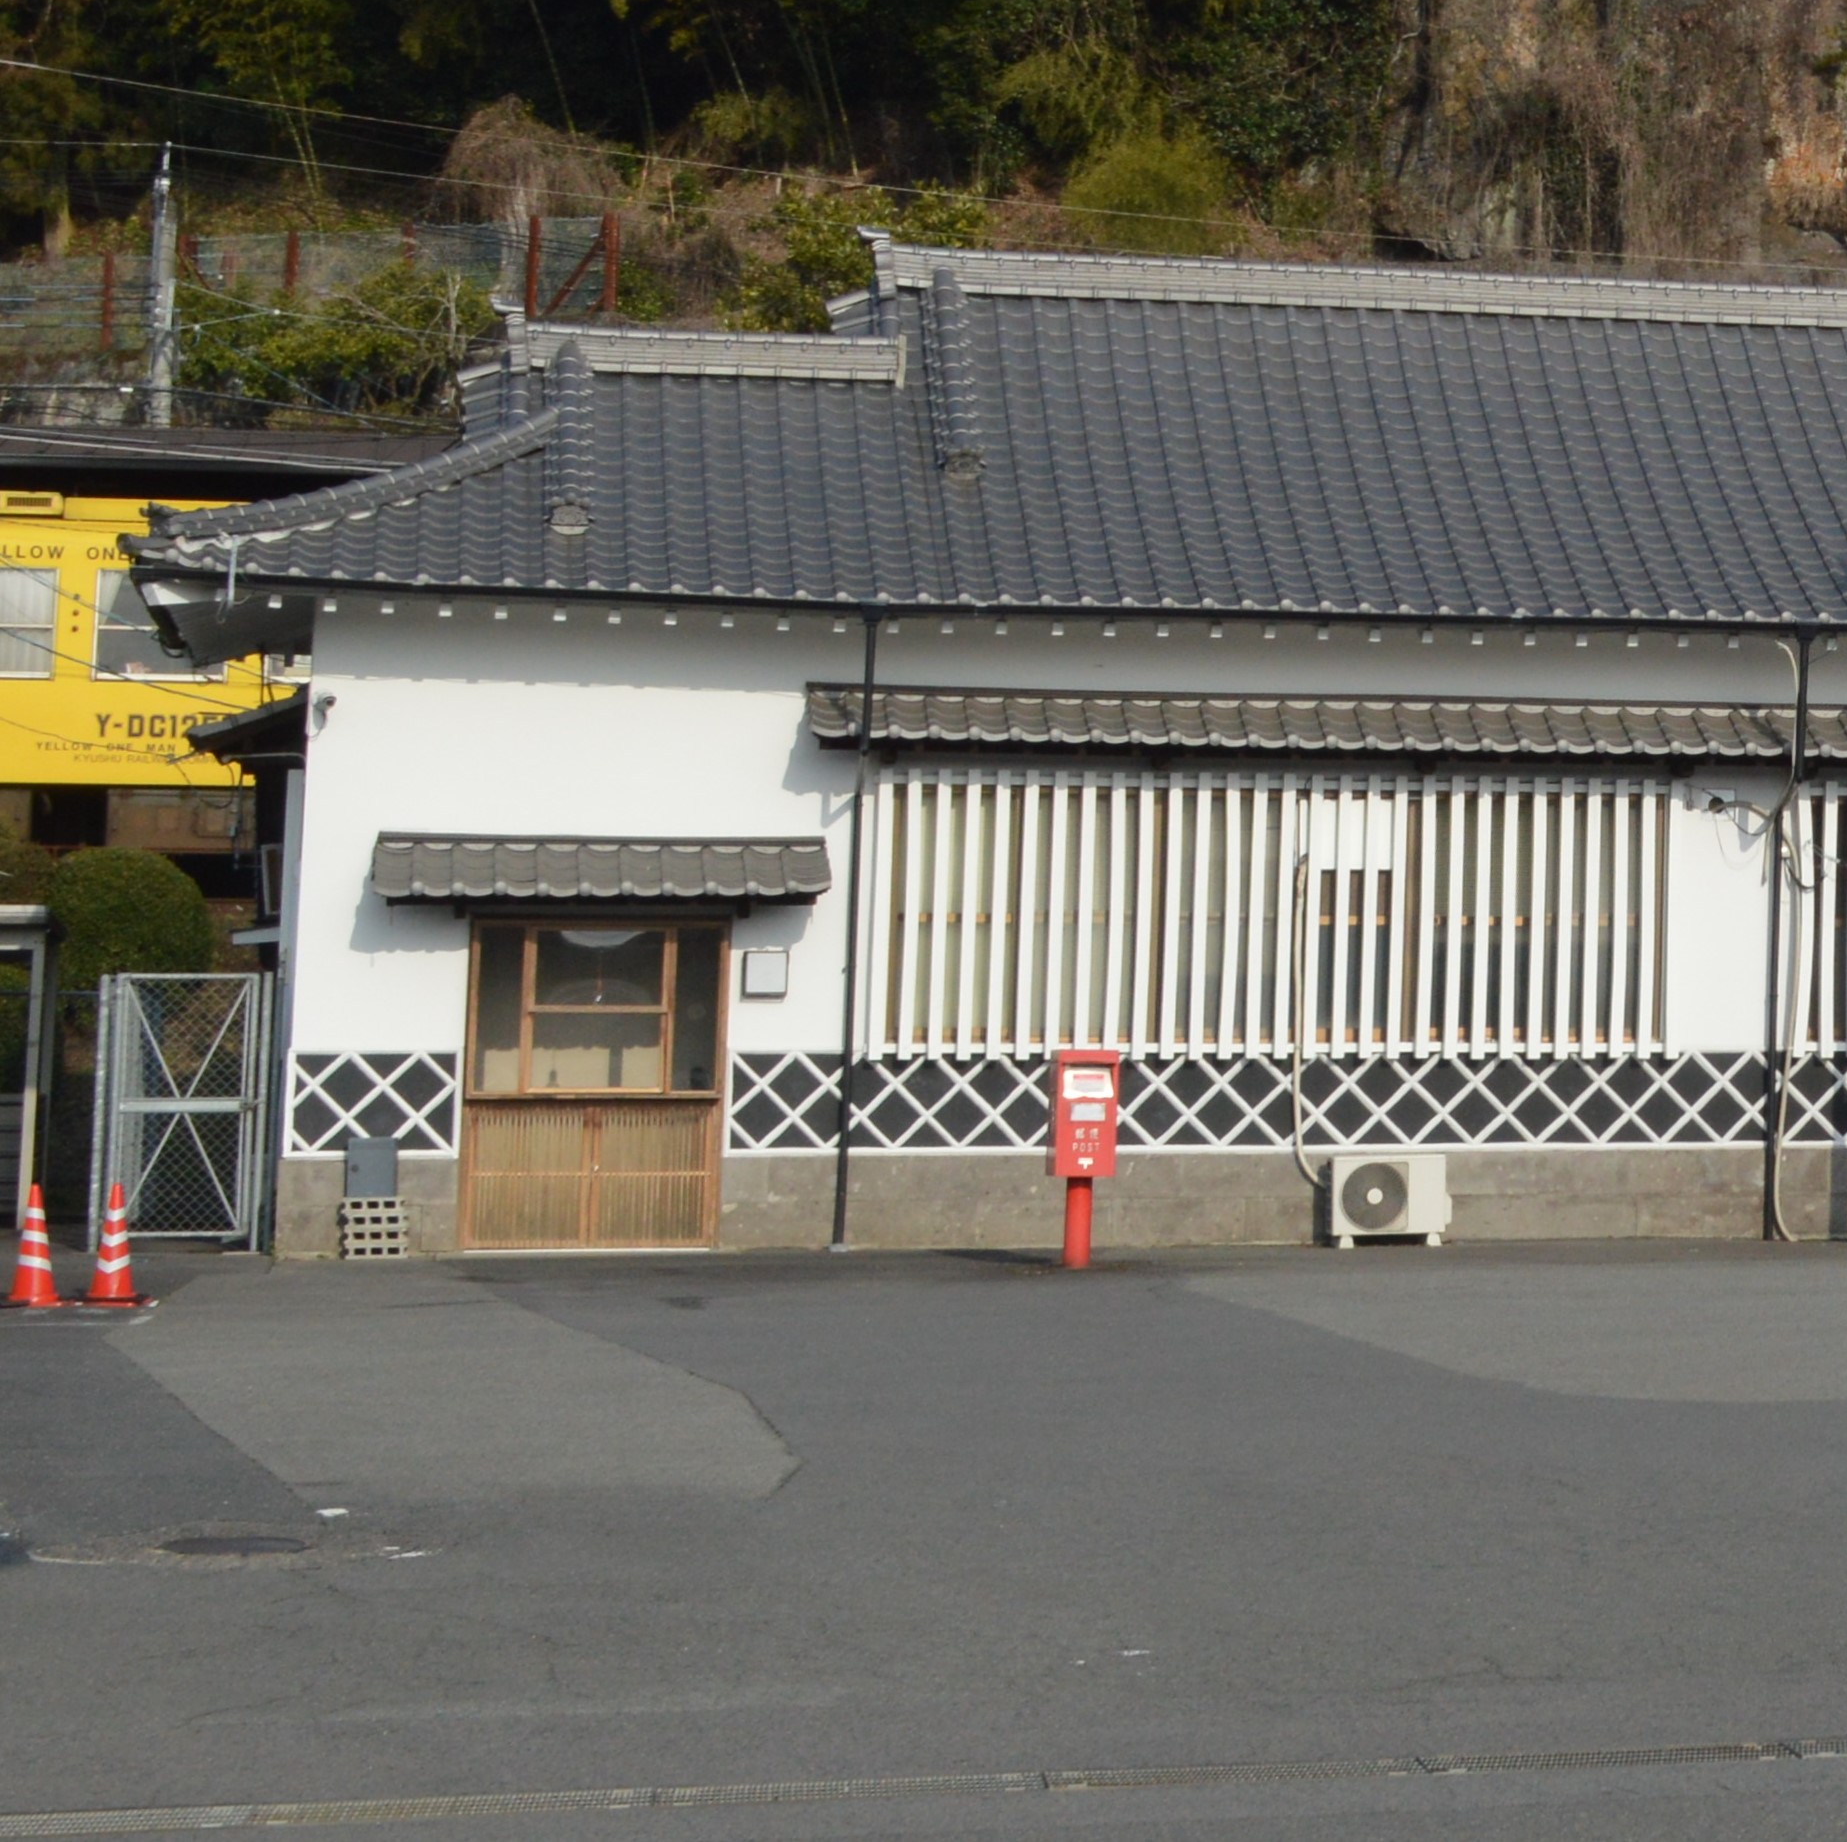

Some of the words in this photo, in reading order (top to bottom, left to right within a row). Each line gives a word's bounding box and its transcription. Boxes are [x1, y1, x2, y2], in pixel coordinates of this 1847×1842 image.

[36, 742, 93, 751] YELLOW
[146, 744, 176, 752] MAN
[1072, 1142, 1100, 1153] POST
